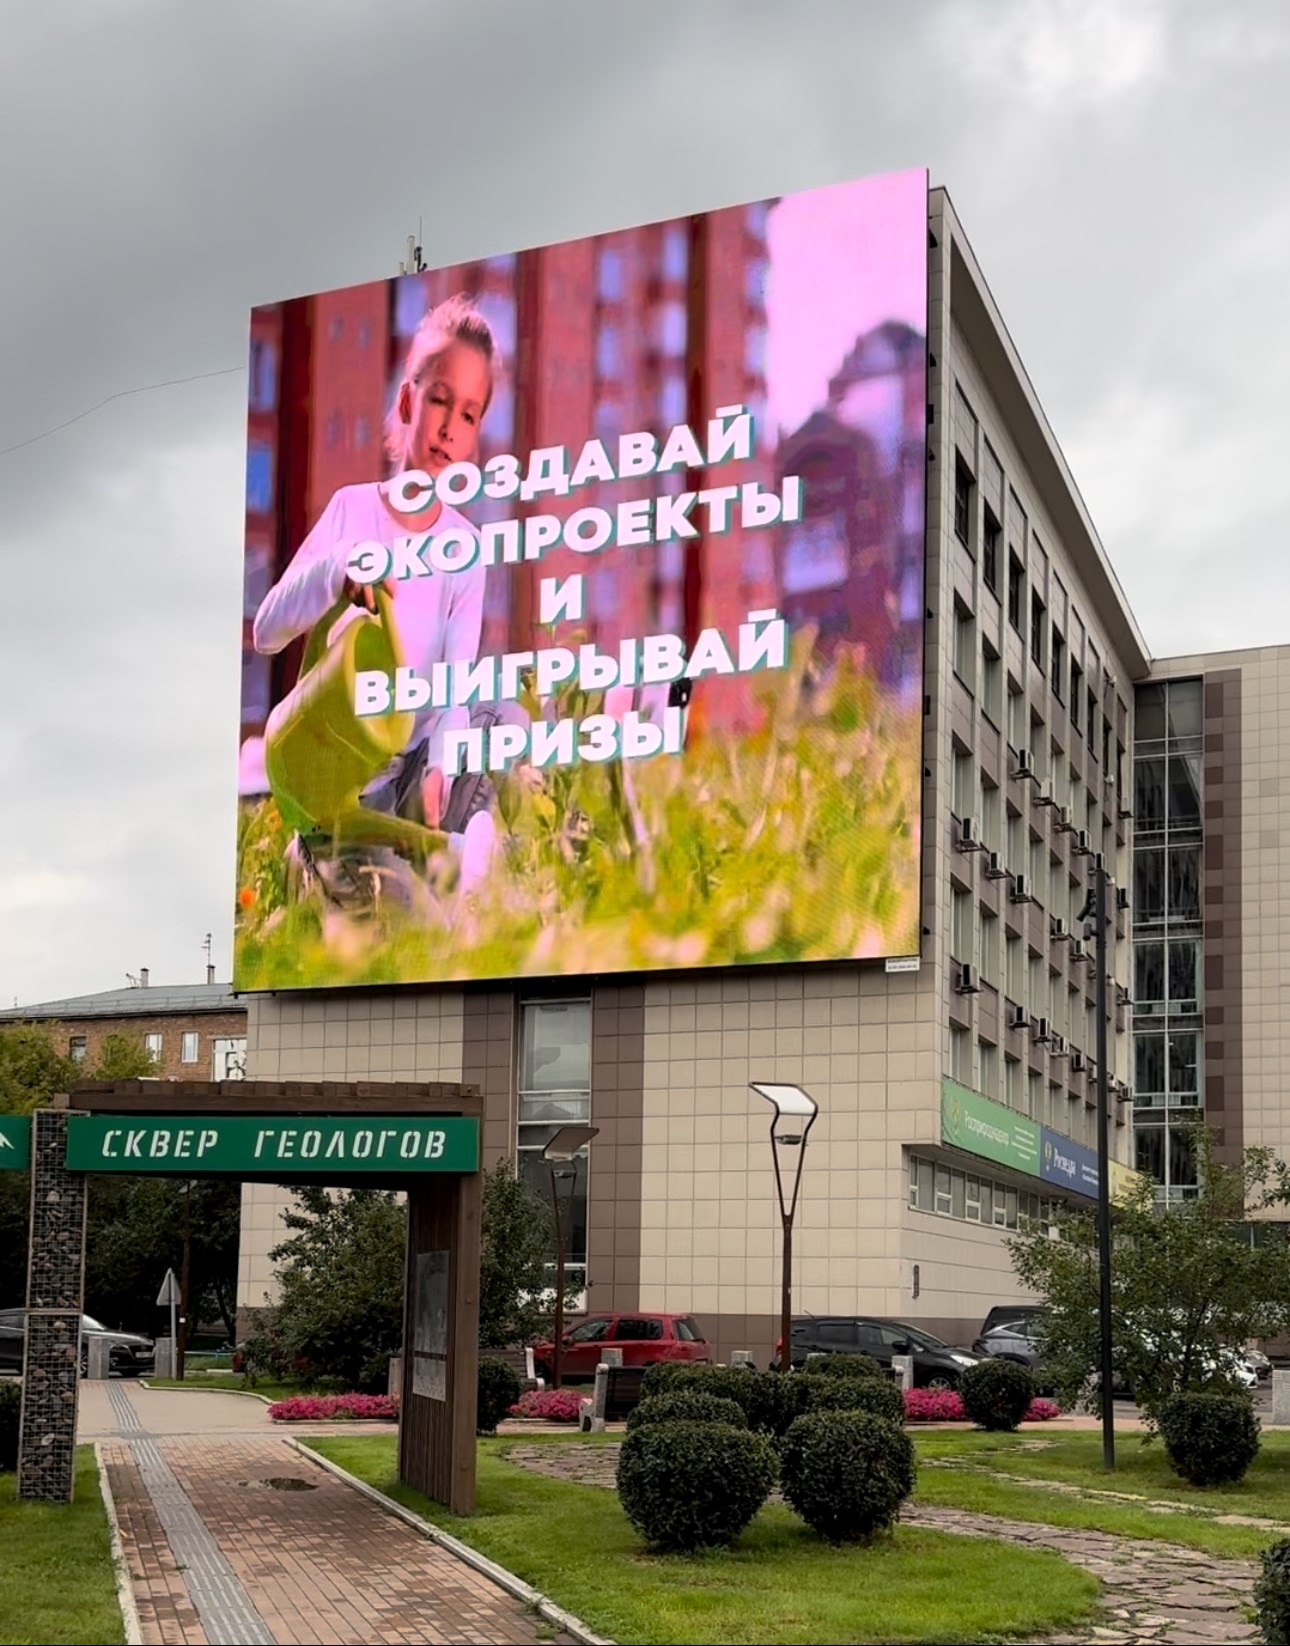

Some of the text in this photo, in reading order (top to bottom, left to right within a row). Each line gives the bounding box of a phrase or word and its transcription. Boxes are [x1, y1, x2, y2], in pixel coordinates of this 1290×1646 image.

[388, 403, 752, 514] СОЗДАВАЙ
[346, 476, 802, 584] ЭКОПРОЕКТЫ
[540, 573, 583, 625] И
[354, 608, 785, 716] ВЫИГРЫВАЙ
[443, 706, 682, 776] ПРИЗЫ
[102, 1129, 447, 1159] СКВЕР ГЕОЛОГОВ
